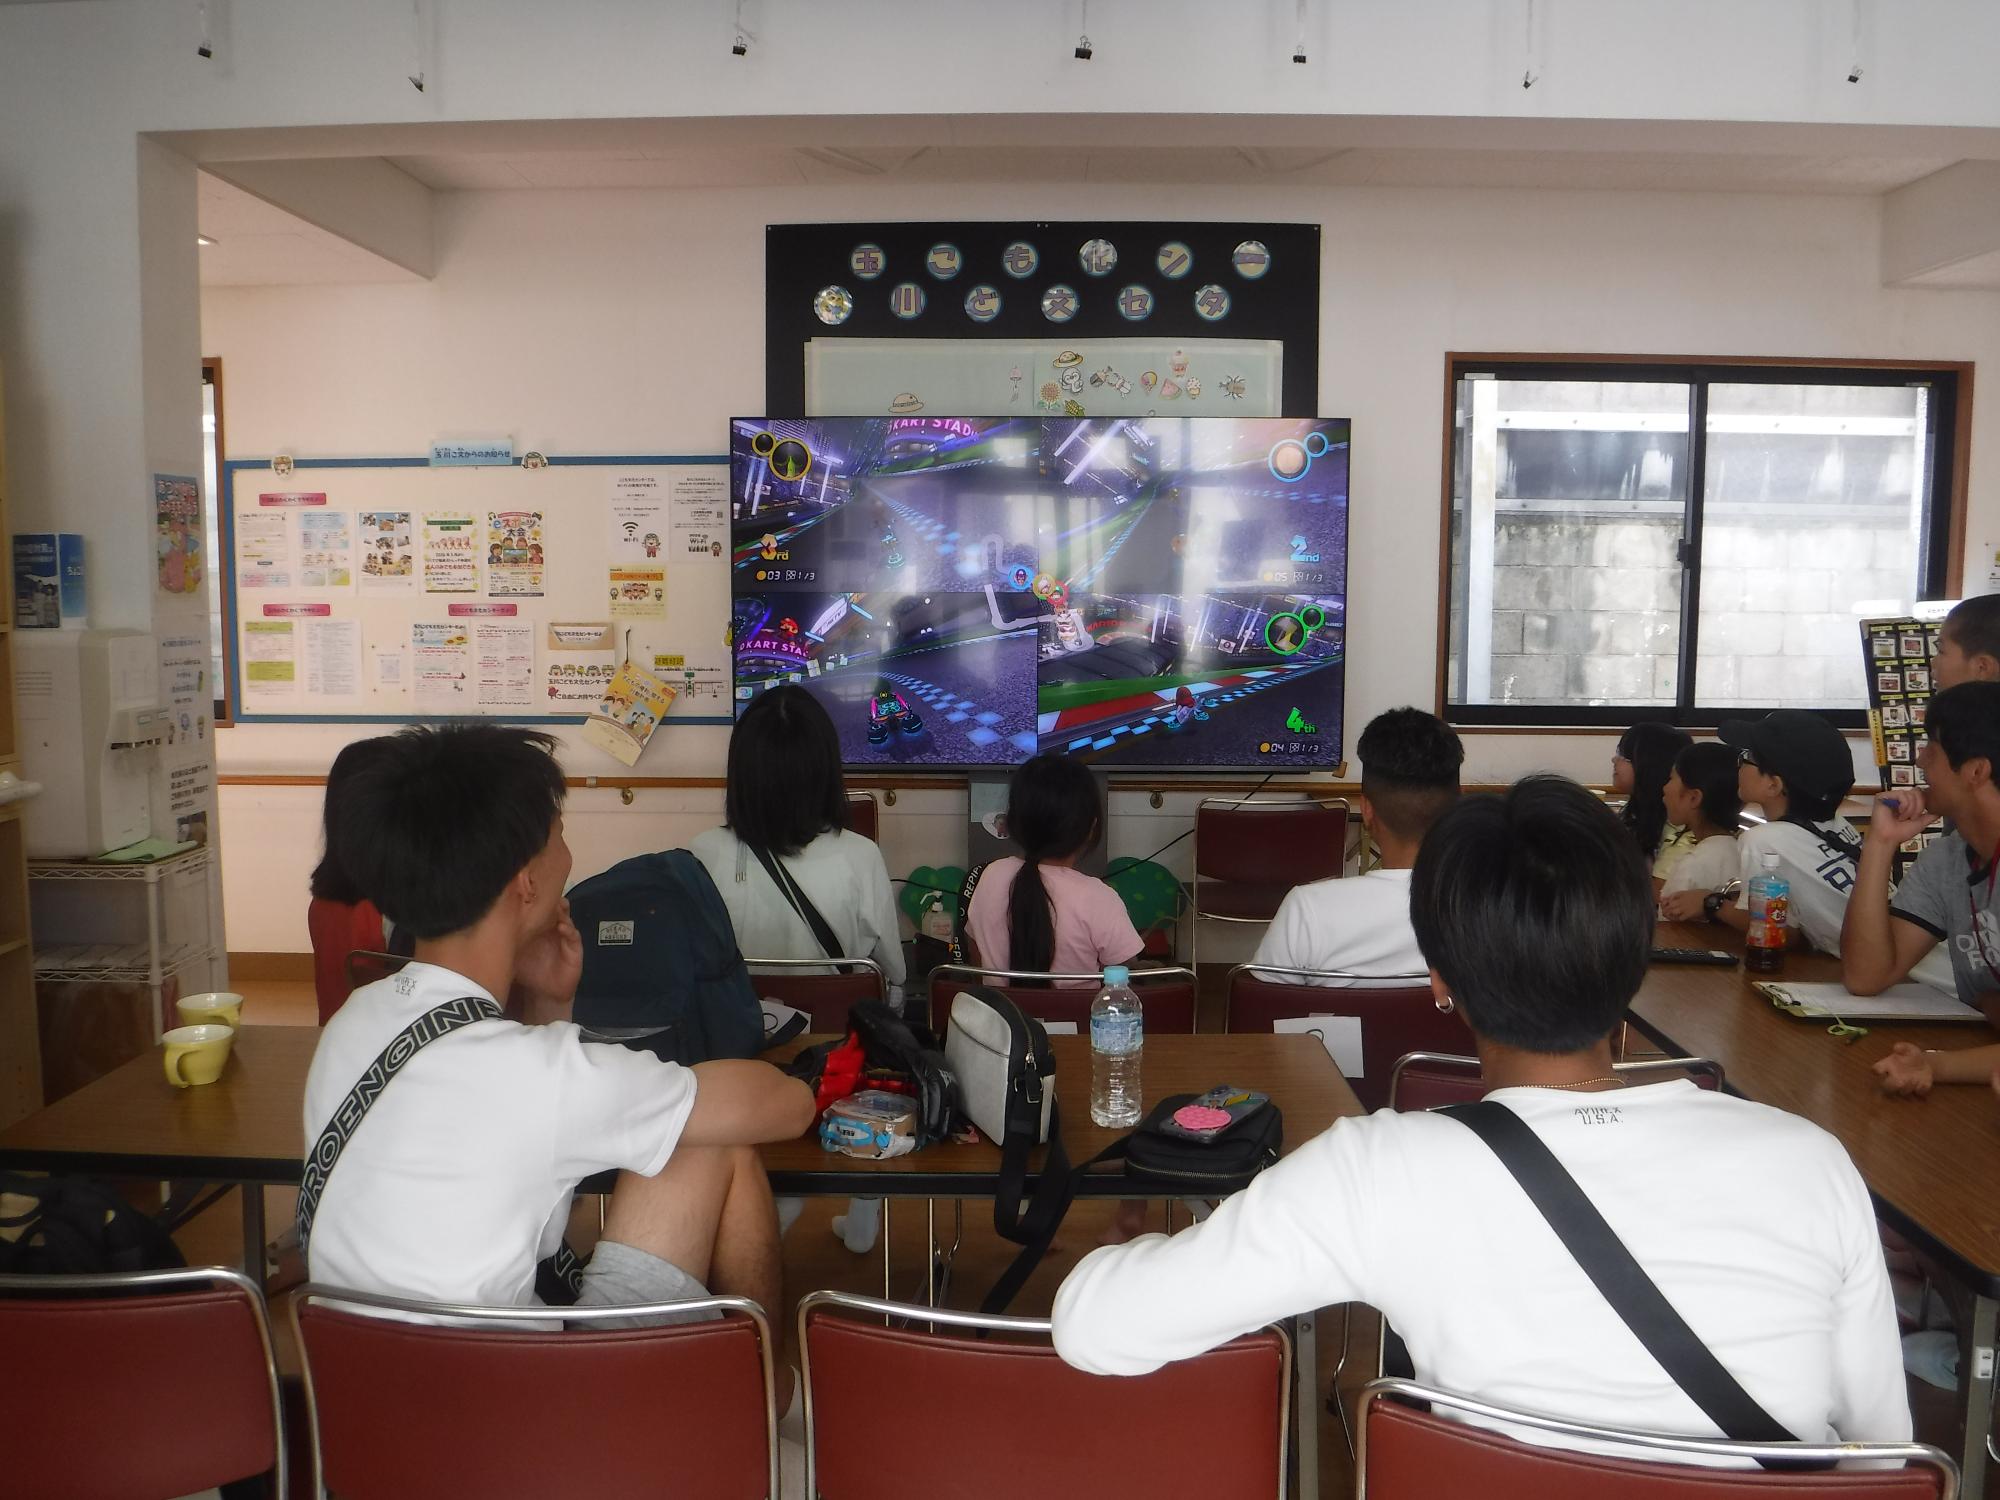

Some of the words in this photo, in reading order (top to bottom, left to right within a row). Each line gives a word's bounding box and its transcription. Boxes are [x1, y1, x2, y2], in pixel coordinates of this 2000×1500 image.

[1290, 535, 1320, 562] 2nd
[767, 570, 781, 580] 03
[1287, 707, 1316, 733] 4th
[1271, 743, 1285, 752] 04
